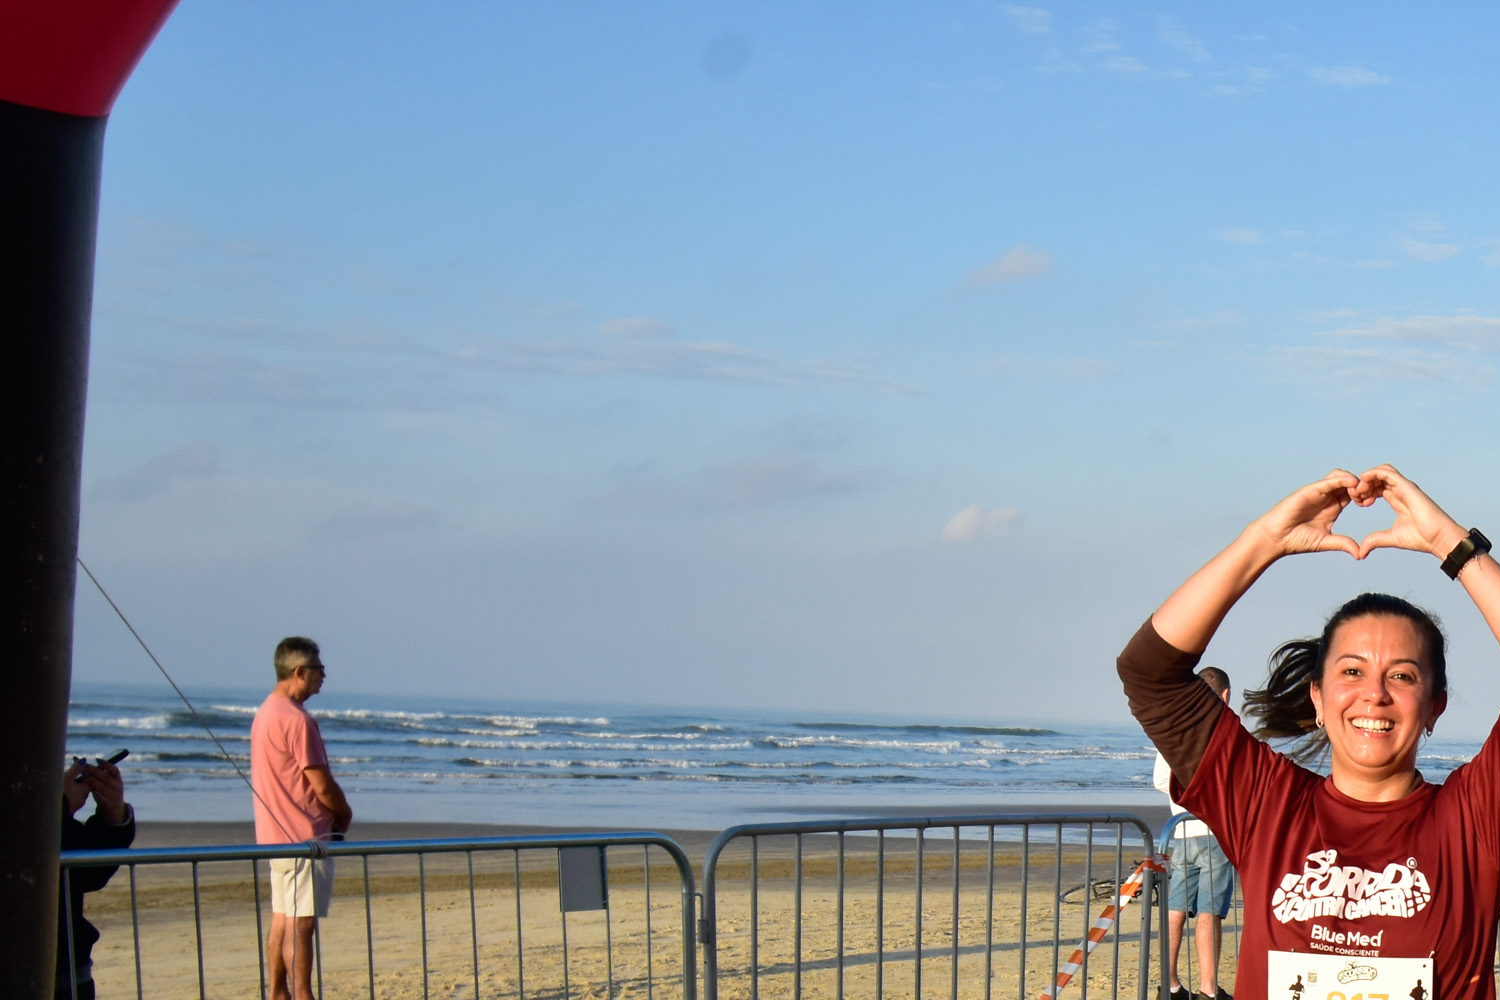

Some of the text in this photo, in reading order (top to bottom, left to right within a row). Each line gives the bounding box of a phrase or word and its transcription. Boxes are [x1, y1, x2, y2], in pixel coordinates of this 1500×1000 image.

[1310, 924, 1384, 948] Blue Med
[1309, 942, 1380, 957] SAÚDE CONSCIENTE
